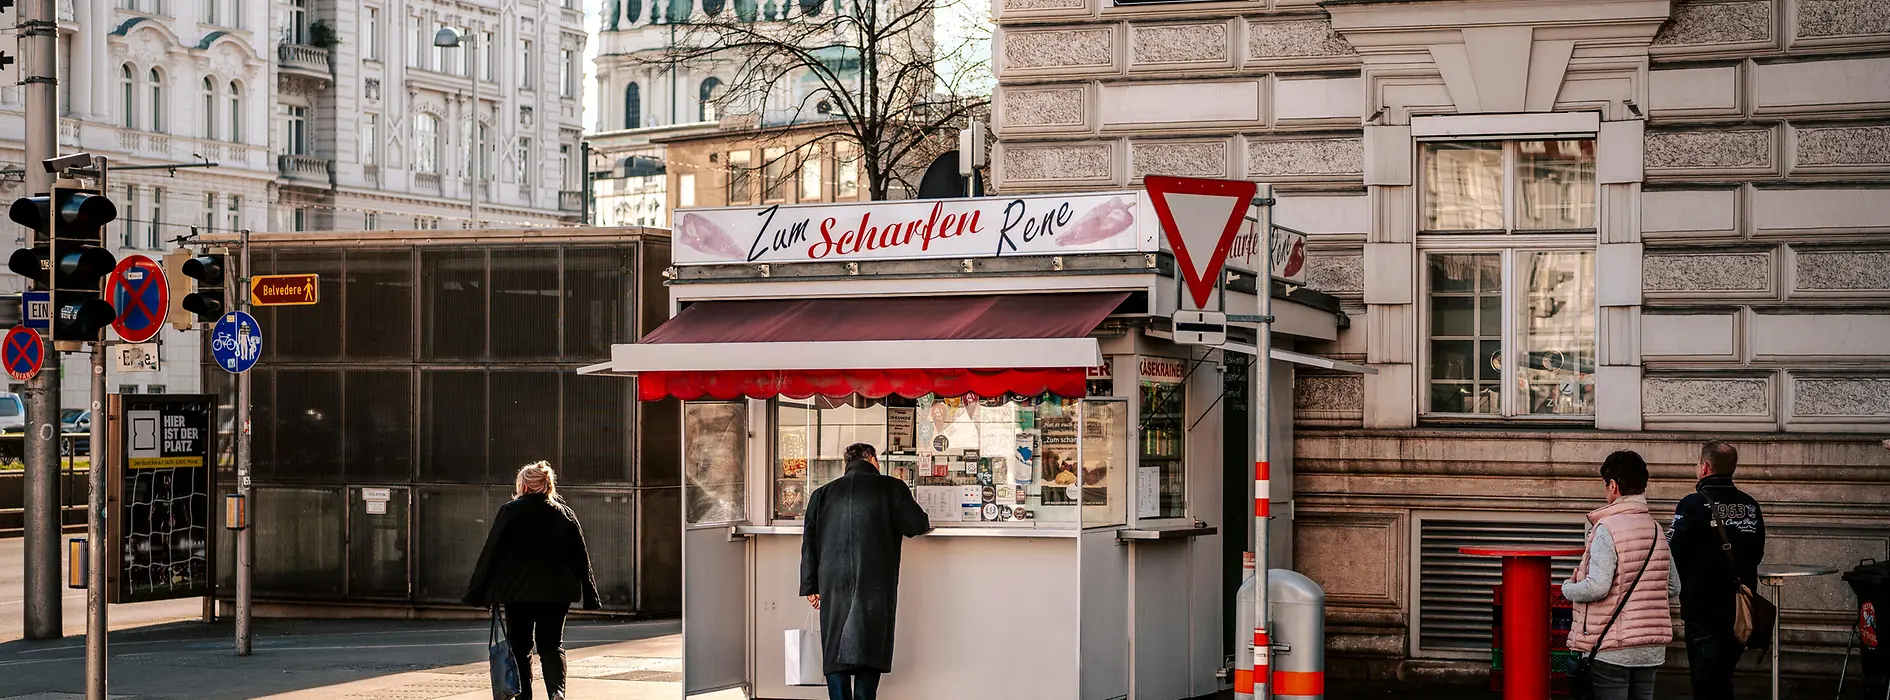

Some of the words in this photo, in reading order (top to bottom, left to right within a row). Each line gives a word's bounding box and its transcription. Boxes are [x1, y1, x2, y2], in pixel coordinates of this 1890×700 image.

[747, 204, 810, 262] Zum
[808, 200, 984, 259] Scharfen
[996, 199, 1074, 257] Rene
[263, 284, 302, 296] Belvedere
[11, 369, 35, 381] ANFANG
[163, 415, 186, 428] HIER
[164, 427, 179, 440] IST
[180, 427, 199, 440] DER
[164, 440, 193, 452] PLATZ
